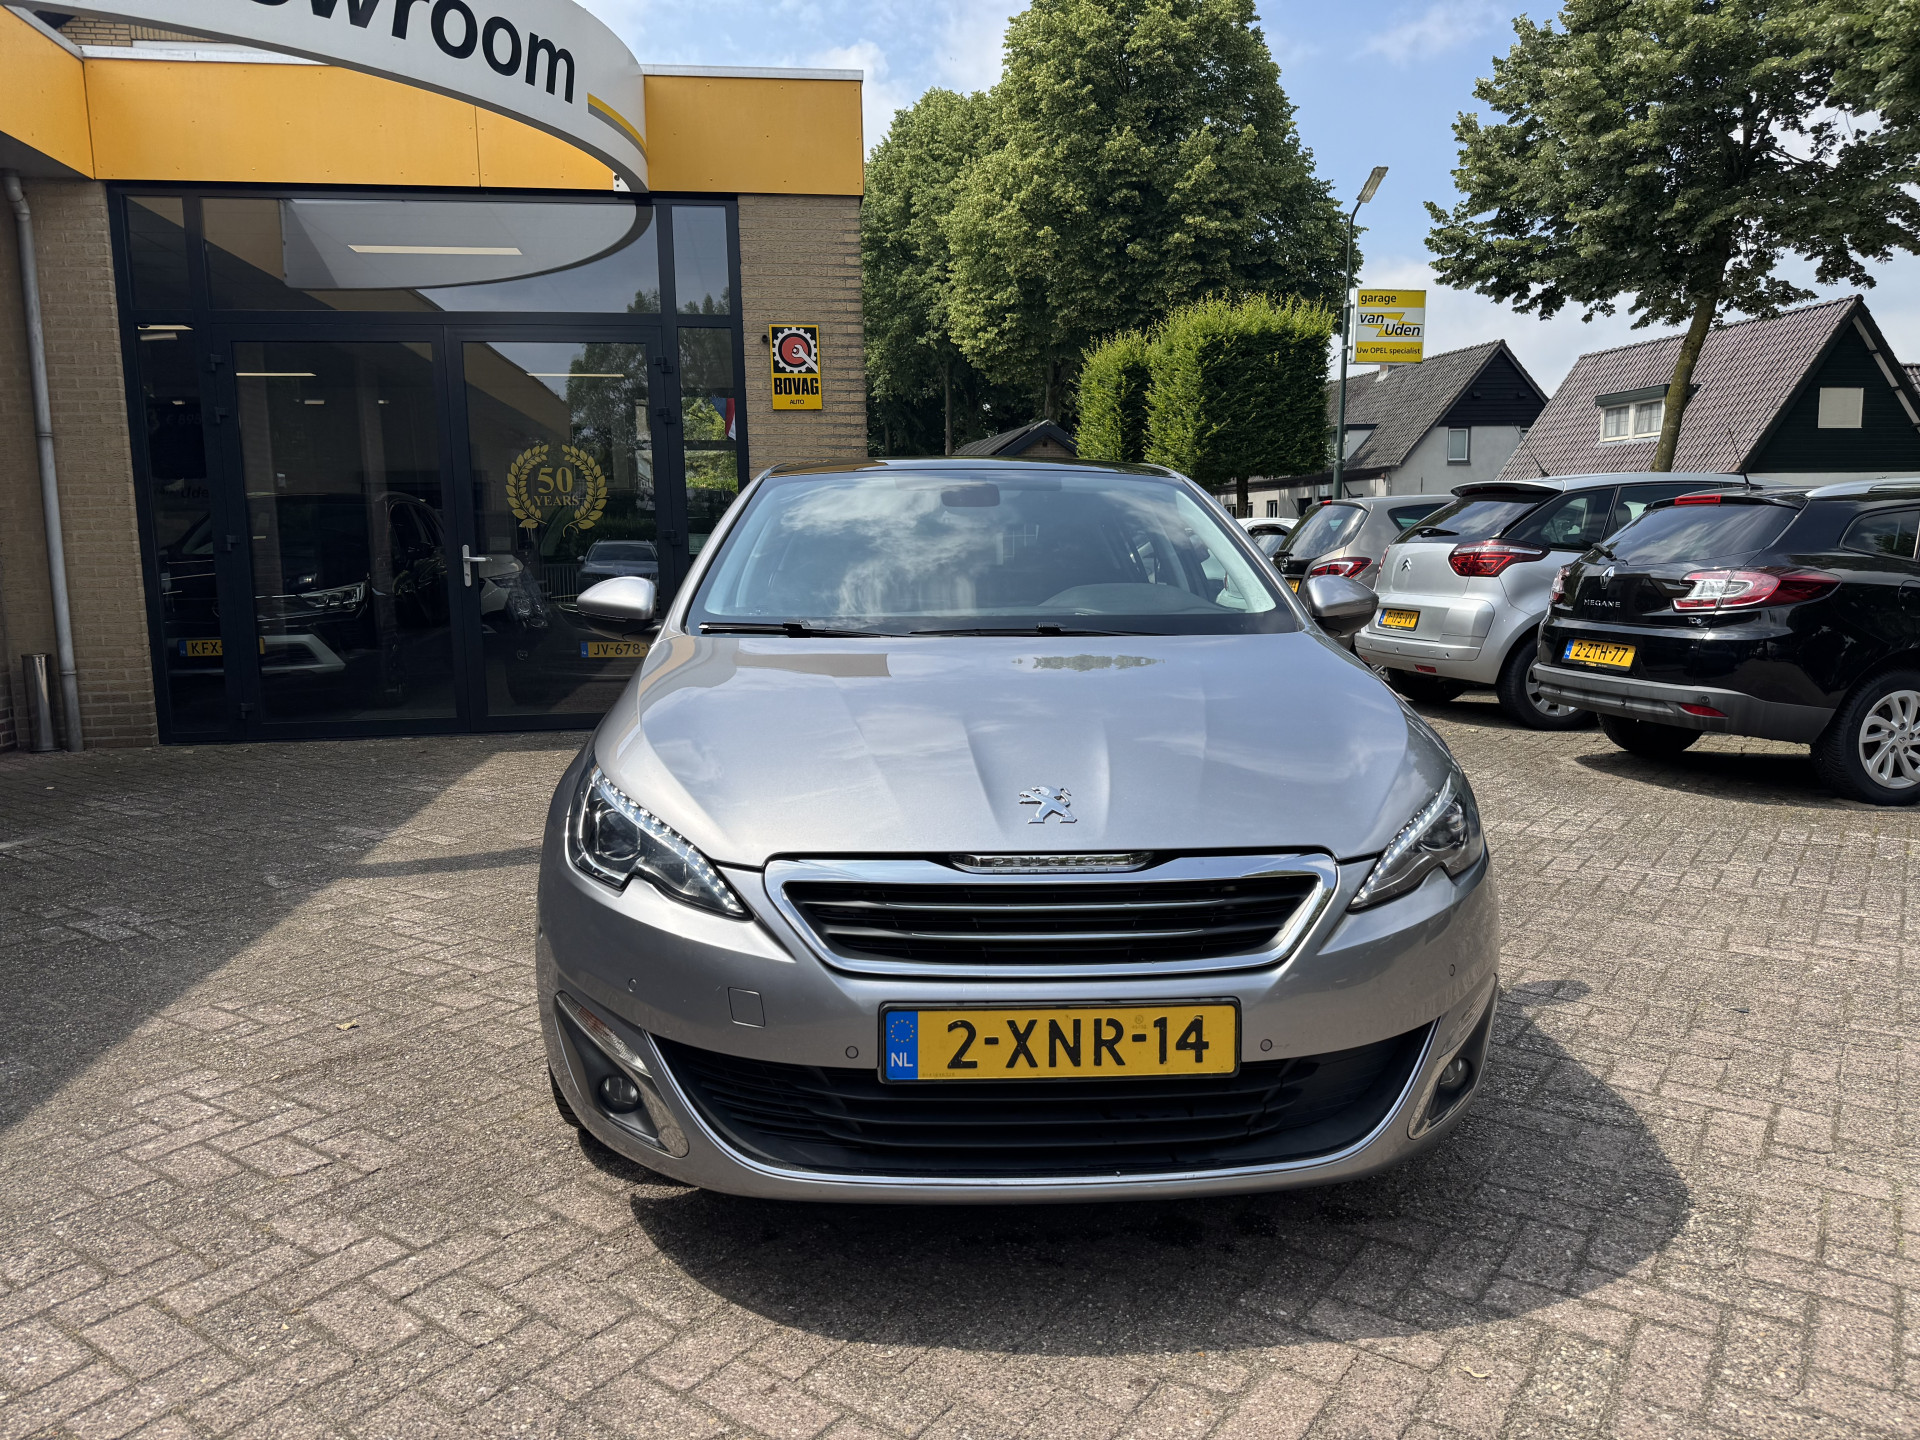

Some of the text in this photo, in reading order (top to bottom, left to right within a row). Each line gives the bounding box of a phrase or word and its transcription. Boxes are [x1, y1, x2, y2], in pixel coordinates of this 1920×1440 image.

[1360, 294, 1397, 305] garage
[1360, 314, 1385, 324] van
[1384, 323, 1420, 336] Uden
[1389, 347, 1421, 356] specialist
[773, 377, 820, 396] BOVAG
[537, 467, 574, 494] 50
[533, 495, 580, 506] YEARS
[1583, 599, 1621, 608] MEGANE
[1574, 642, 1629, 663] 2-ZTH-77
[890, 1014, 1210, 1070] NL 2-XNR-14
